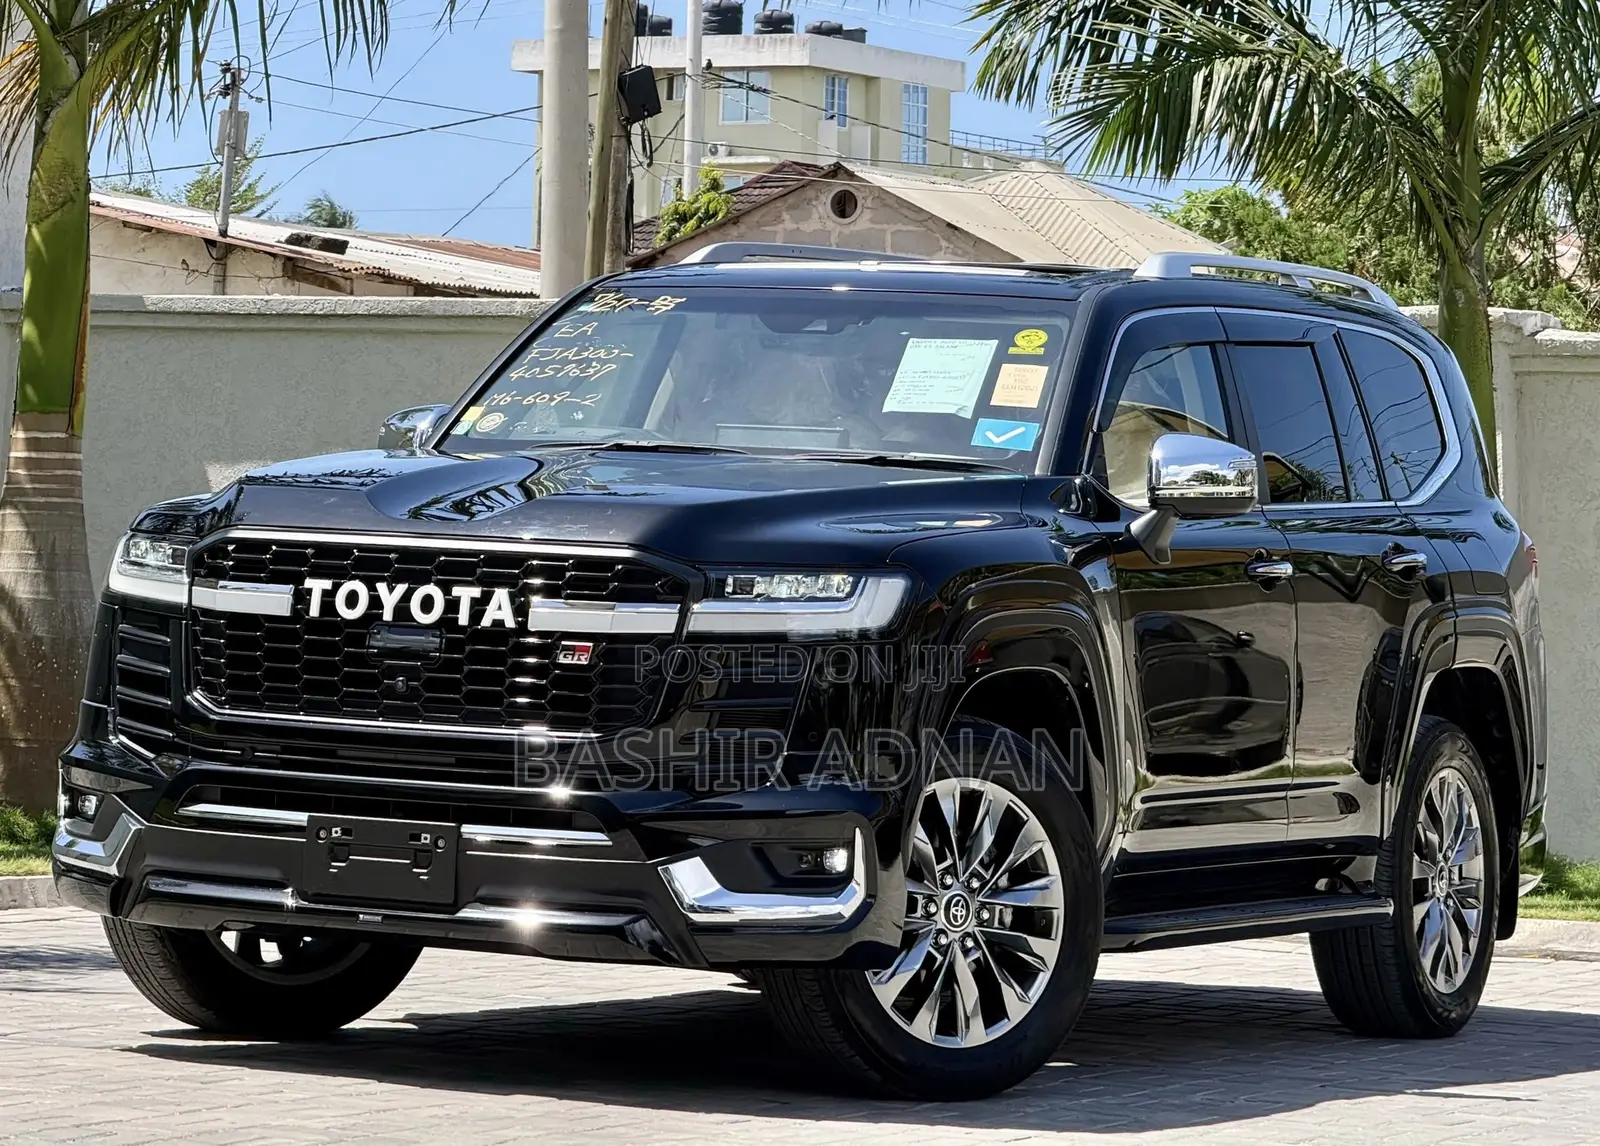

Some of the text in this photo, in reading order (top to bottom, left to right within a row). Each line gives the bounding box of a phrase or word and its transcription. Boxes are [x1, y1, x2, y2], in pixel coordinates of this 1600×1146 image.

[554, 322, 598, 338] EA
[304, 578, 516, 628] TOYOTA
[557, 648, 592, 664] GR
